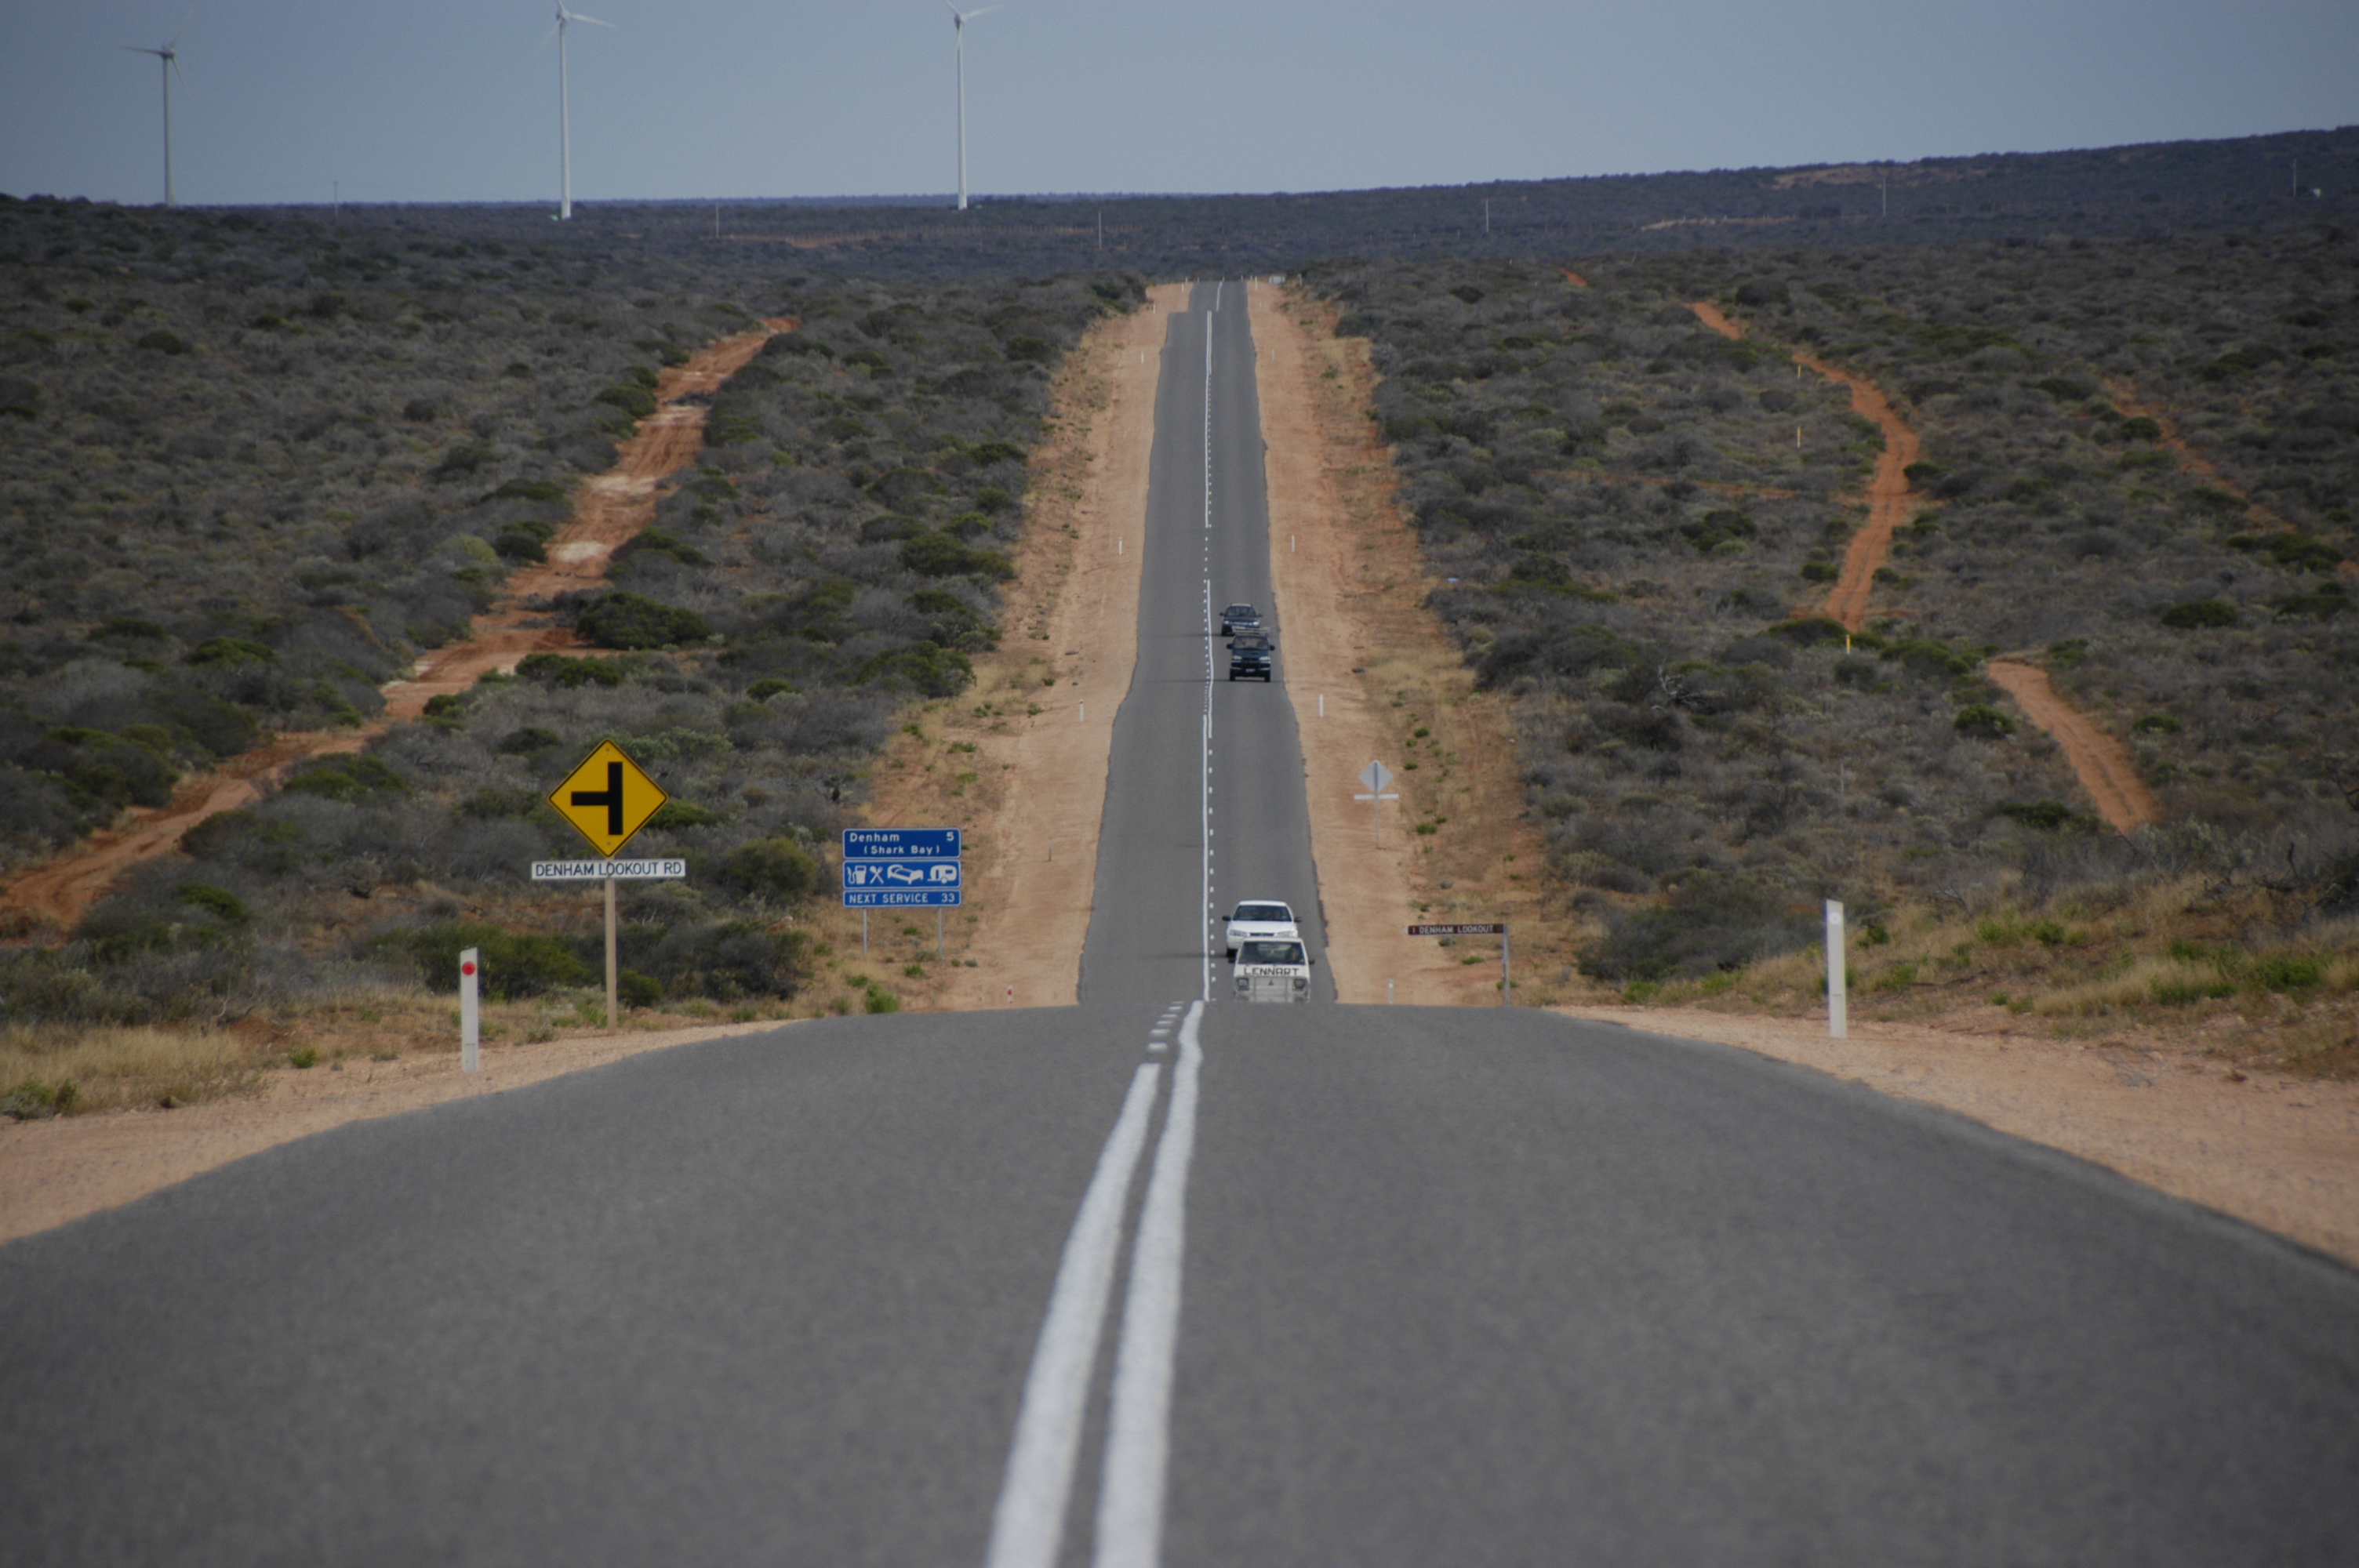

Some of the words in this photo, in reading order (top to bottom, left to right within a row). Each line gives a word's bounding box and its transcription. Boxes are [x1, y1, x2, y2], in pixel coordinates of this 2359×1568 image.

[849, 832, 900, 842] Denham
[946, 831, 954, 841] 5
[536, 862, 594, 877] DENHAM
[598, 861, 659, 877] LOOKOUT
[663, 861, 682, 875] RD
[849, 894, 877, 904] NEXT
[882, 893, 929, 903] SERVICE
[941, 893, 955, 902] 33
[1243, 967, 1299, 976] LENNART
